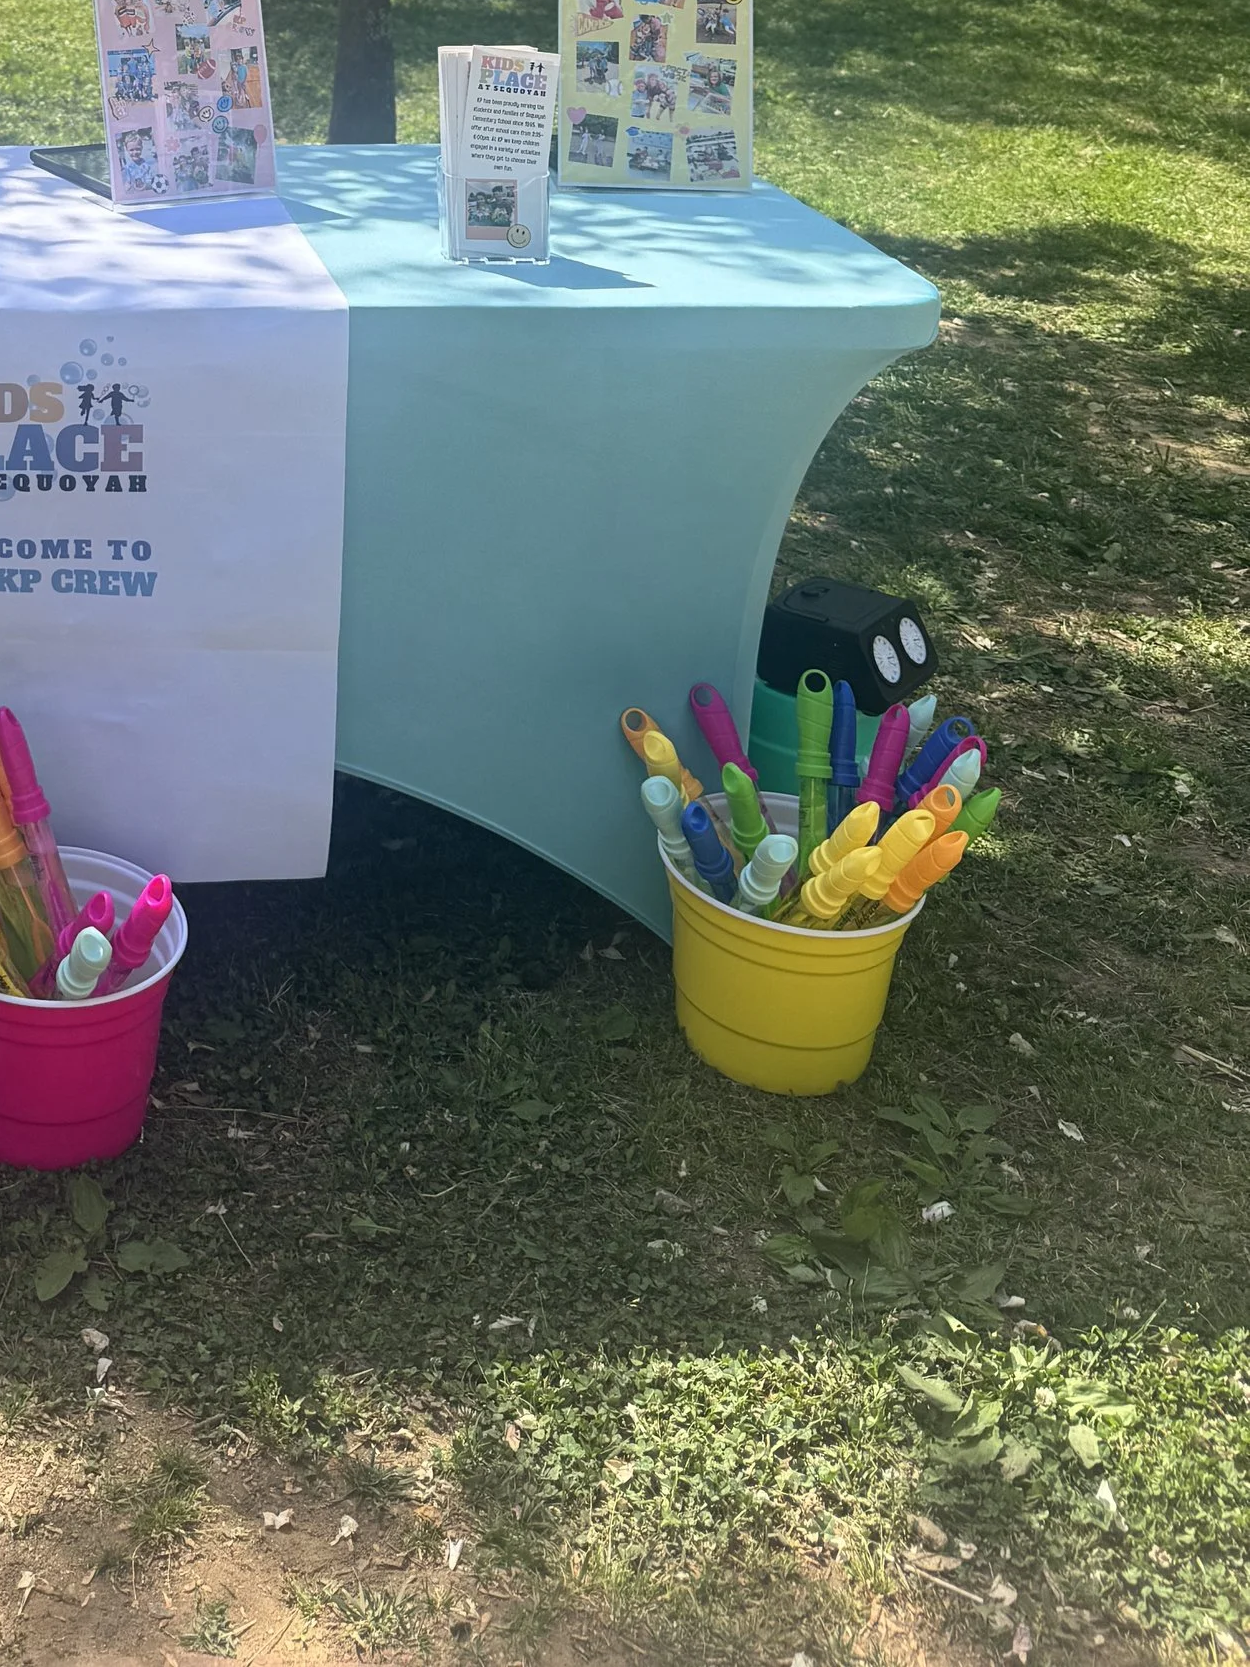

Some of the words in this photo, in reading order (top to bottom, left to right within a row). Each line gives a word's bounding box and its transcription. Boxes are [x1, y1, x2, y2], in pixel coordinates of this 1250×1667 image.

[481, 55, 525, 72] KIDS
[479, 69, 548, 90] PLACE
[493, 85, 546, 97] SEQUOYAH
[107, 539, 152, 562] TO
[51, 568, 158, 597] CREW
